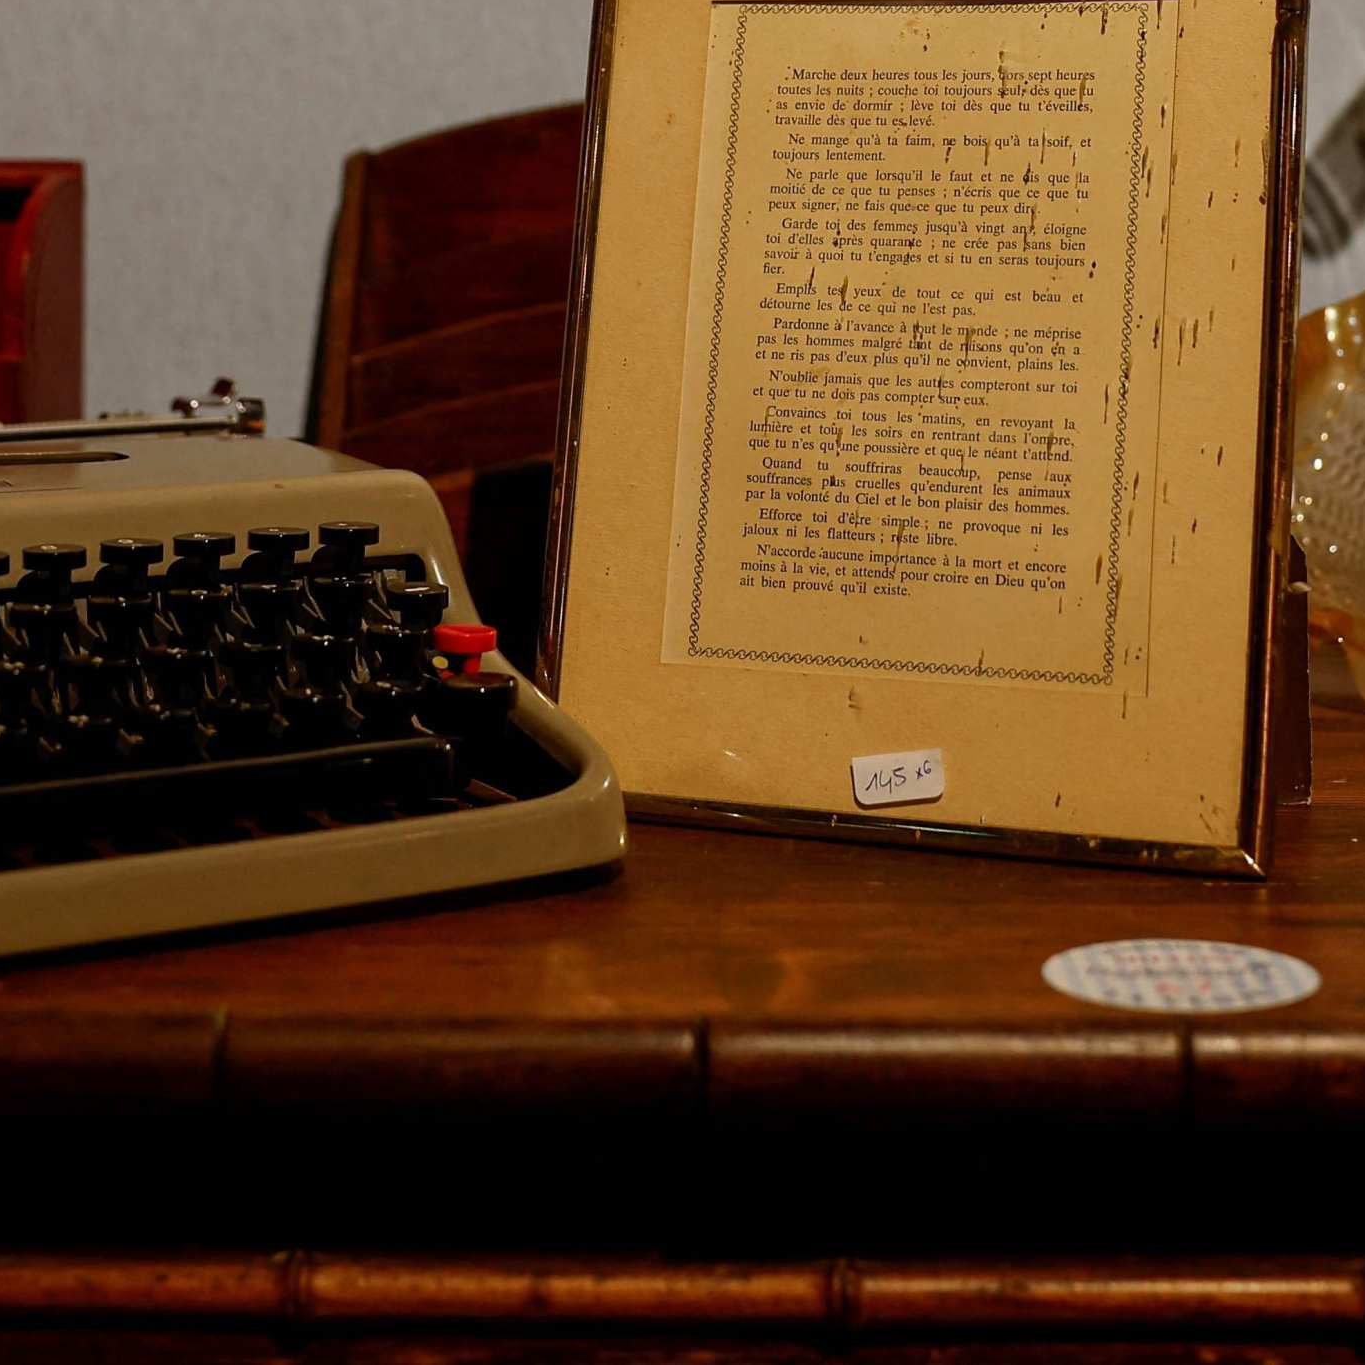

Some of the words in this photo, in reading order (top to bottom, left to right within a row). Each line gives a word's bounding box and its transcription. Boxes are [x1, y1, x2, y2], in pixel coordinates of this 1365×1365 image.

[791, 69, 837, 80] Marche
[839, 69, 868, 80] deux
[872, 69, 910, 80] heures
[913, 70, 938, 80] tous
[961, 70, 995, 83] jours,
[1027, 70, 1052, 83] sept
[1056, 69, 1095, 80] heures
[776, 85, 812, 95] toutes
[836, 85, 865, 96] nuits
[877, 85, 919, 96] couche
[923, 85, 939, 95] toi
[943, 85, 993, 98] toujours
[1029, 85, 1050, 96] dès
[794, 100, 826, 110] envie
[852, 100, 893, 111] dormir
[910, 99, 934, 111] lève
[940, 100, 956, 111] toi
[962, 100, 983, 111] dès
[1037, 100, 1093, 113] t'éveilles,
[774, 114, 822, 125] travaille
[826, 114, 845, 125] dès
[908, 115, 935, 126] levé.
[810, 137, 850, 148] mange
[854, 134, 881, 148] qu'à
[904, 134, 935, 147] faim,
[963, 135, 987, 146] bois
[994, 135, 1020, 149] qu'à
[1046, 136, 1073, 149] soif,
[772, 149, 820, 163] toujours
[826, 149, 885, 161] lentement.
[809, 169, 839, 183] parle
[875, 169, 923, 184] lorsqu'il
[949, 170, 973, 182] faut
[769, 183, 806, 194] moitié
[896, 188, 936, 199] penses
[952, 186, 992, 198] n'écris
[768, 201, 796, 212] peux
[800, 199, 840, 213] signer,
[864, 200, 885, 211] fais
[781, 218, 819, 230] Garde
[824, 219, 841, 230] toi
[846, 219, 866, 231] des
[872, 220, 918, 232] femmes
[925, 221, 968, 235] jusqu'à
[974, 222, 1005, 236] vingt
[1043, 223, 1087, 238] éloigne
[765, 233, 781, 244] toi
[787, 233, 824, 245] d'elles
[963, 237, 989, 249] crée
[995, 241, 1019, 252] pas
[1025, 242, 1052, 250] sans
[1059, 239, 1086, 251] bien
[762, 263, 785, 274] fier.
[764, 248, 800, 259] savoir
[817, 249, 844, 263] quoi
[998, 257, 1029, 265] seras
[1034, 254, 1085, 269] toujours
[852, 288, 881, 299] yeux
[916, 288, 940, 299] tout
[974, 289, 994, 303] qui
[1004, 291, 1021, 301] est
[1032, 290, 1061, 302] beau
[759, 298, 811, 310] détourne
[876, 302, 896, 315] qui
[922, 303, 946, 315] l'est
[952, 307, 976, 318] pas.
[772, 318, 830, 330] Pardonne
[846, 320, 895, 333] l'avance
[1033, 327, 1082, 342] méprise
[756, 335, 777, 347] pas
[805, 335, 855, 347] hommes
[861, 336, 903, 351] malgré
[1008, 342, 1044, 357] qu'on
[789, 349, 805, 361] ris
[809, 353, 830, 364] pas
[834, 351, 868, 363] d'eux
[872, 352, 899, 367] plus
[902, 353, 930, 368] qu'il
[1016, 358, 1053, 373] plains
[1059, 359, 1079, 371] les.
[768, 370, 819, 383] N'oublie
[822, 373, 862, 388] jamais
[959, 379, 1030, 394] compteront
[1036, 384, 1055, 392] sur
[1061, 382, 1077, 393] toi
[830, 388, 856, 400] dois
[859, 392, 880, 404] pas
[883, 392, 935, 406] compter
[963, 397, 989, 406] eux.
[836, 409, 852, 420] toi
[861, 411, 887, 422] tous
[921, 413, 966, 427] matins,
[1000, 417, 1054, 432] revoyant
[874, 426, 903, 438] soirs
[931, 430, 981, 442] rentrant
[987, 431, 1017, 443] dans
[791, 438, 815, 450] n'es
[863, 441, 920, 457] poussière
[983, 447, 1017, 459] néant
[761, 457, 802, 472] Quand
[844, 461, 902, 474] souffriras
[997, 471, 1032, 484] pense
[1049, 473, 1072, 482] aux
[745, 472, 813, 486] souffrances
[854, 477, 901, 490] cruelles
[909, 480, 983, 497] qu'endurent
[1017, 486, 1071, 499] animaux
[744, 490, 766, 502] par
[785, 489, 830, 503] volonté
[854, 493, 881, 505] Ciel
[914, 496, 940, 508] bon
[944, 497, 983, 513] plaisir
[987, 500, 1009, 512] des
[1014, 501, 1070, 515] hommes.
[758, 508, 802, 521] Efforce
[811, 511, 828, 523] toi
[880, 515, 920, 531] simple
[962, 522, 1021, 536] provoque
[742, 523, 779, 539] jaloux
[826, 528, 876, 541] flatteurs
[926, 533, 957, 546] libre.
[756, 544, 817, 558] N'accorde
[822, 551, 865, 561] aucune
[972, 558, 1002, 570] mort
[1025, 563, 1066, 573] encore
[739, 575, 755, 587] ait
[760, 576, 786, 589] bien
[792, 578, 834, 594] prouvé
[839, 581, 867, 596] qu'il
[873, 583, 911, 596] existe.
[740, 559, 776, 572] moins
[808, 563, 830, 577] vie,
[851, 565, 896, 579] attends
[897, 571, 929, 584] pour
[932, 571, 969, 584] croire
[994, 574, 1025, 587] Dieu
[1028, 576, 1066, 592] qu'on
[865, 765, 907, 795] 145
